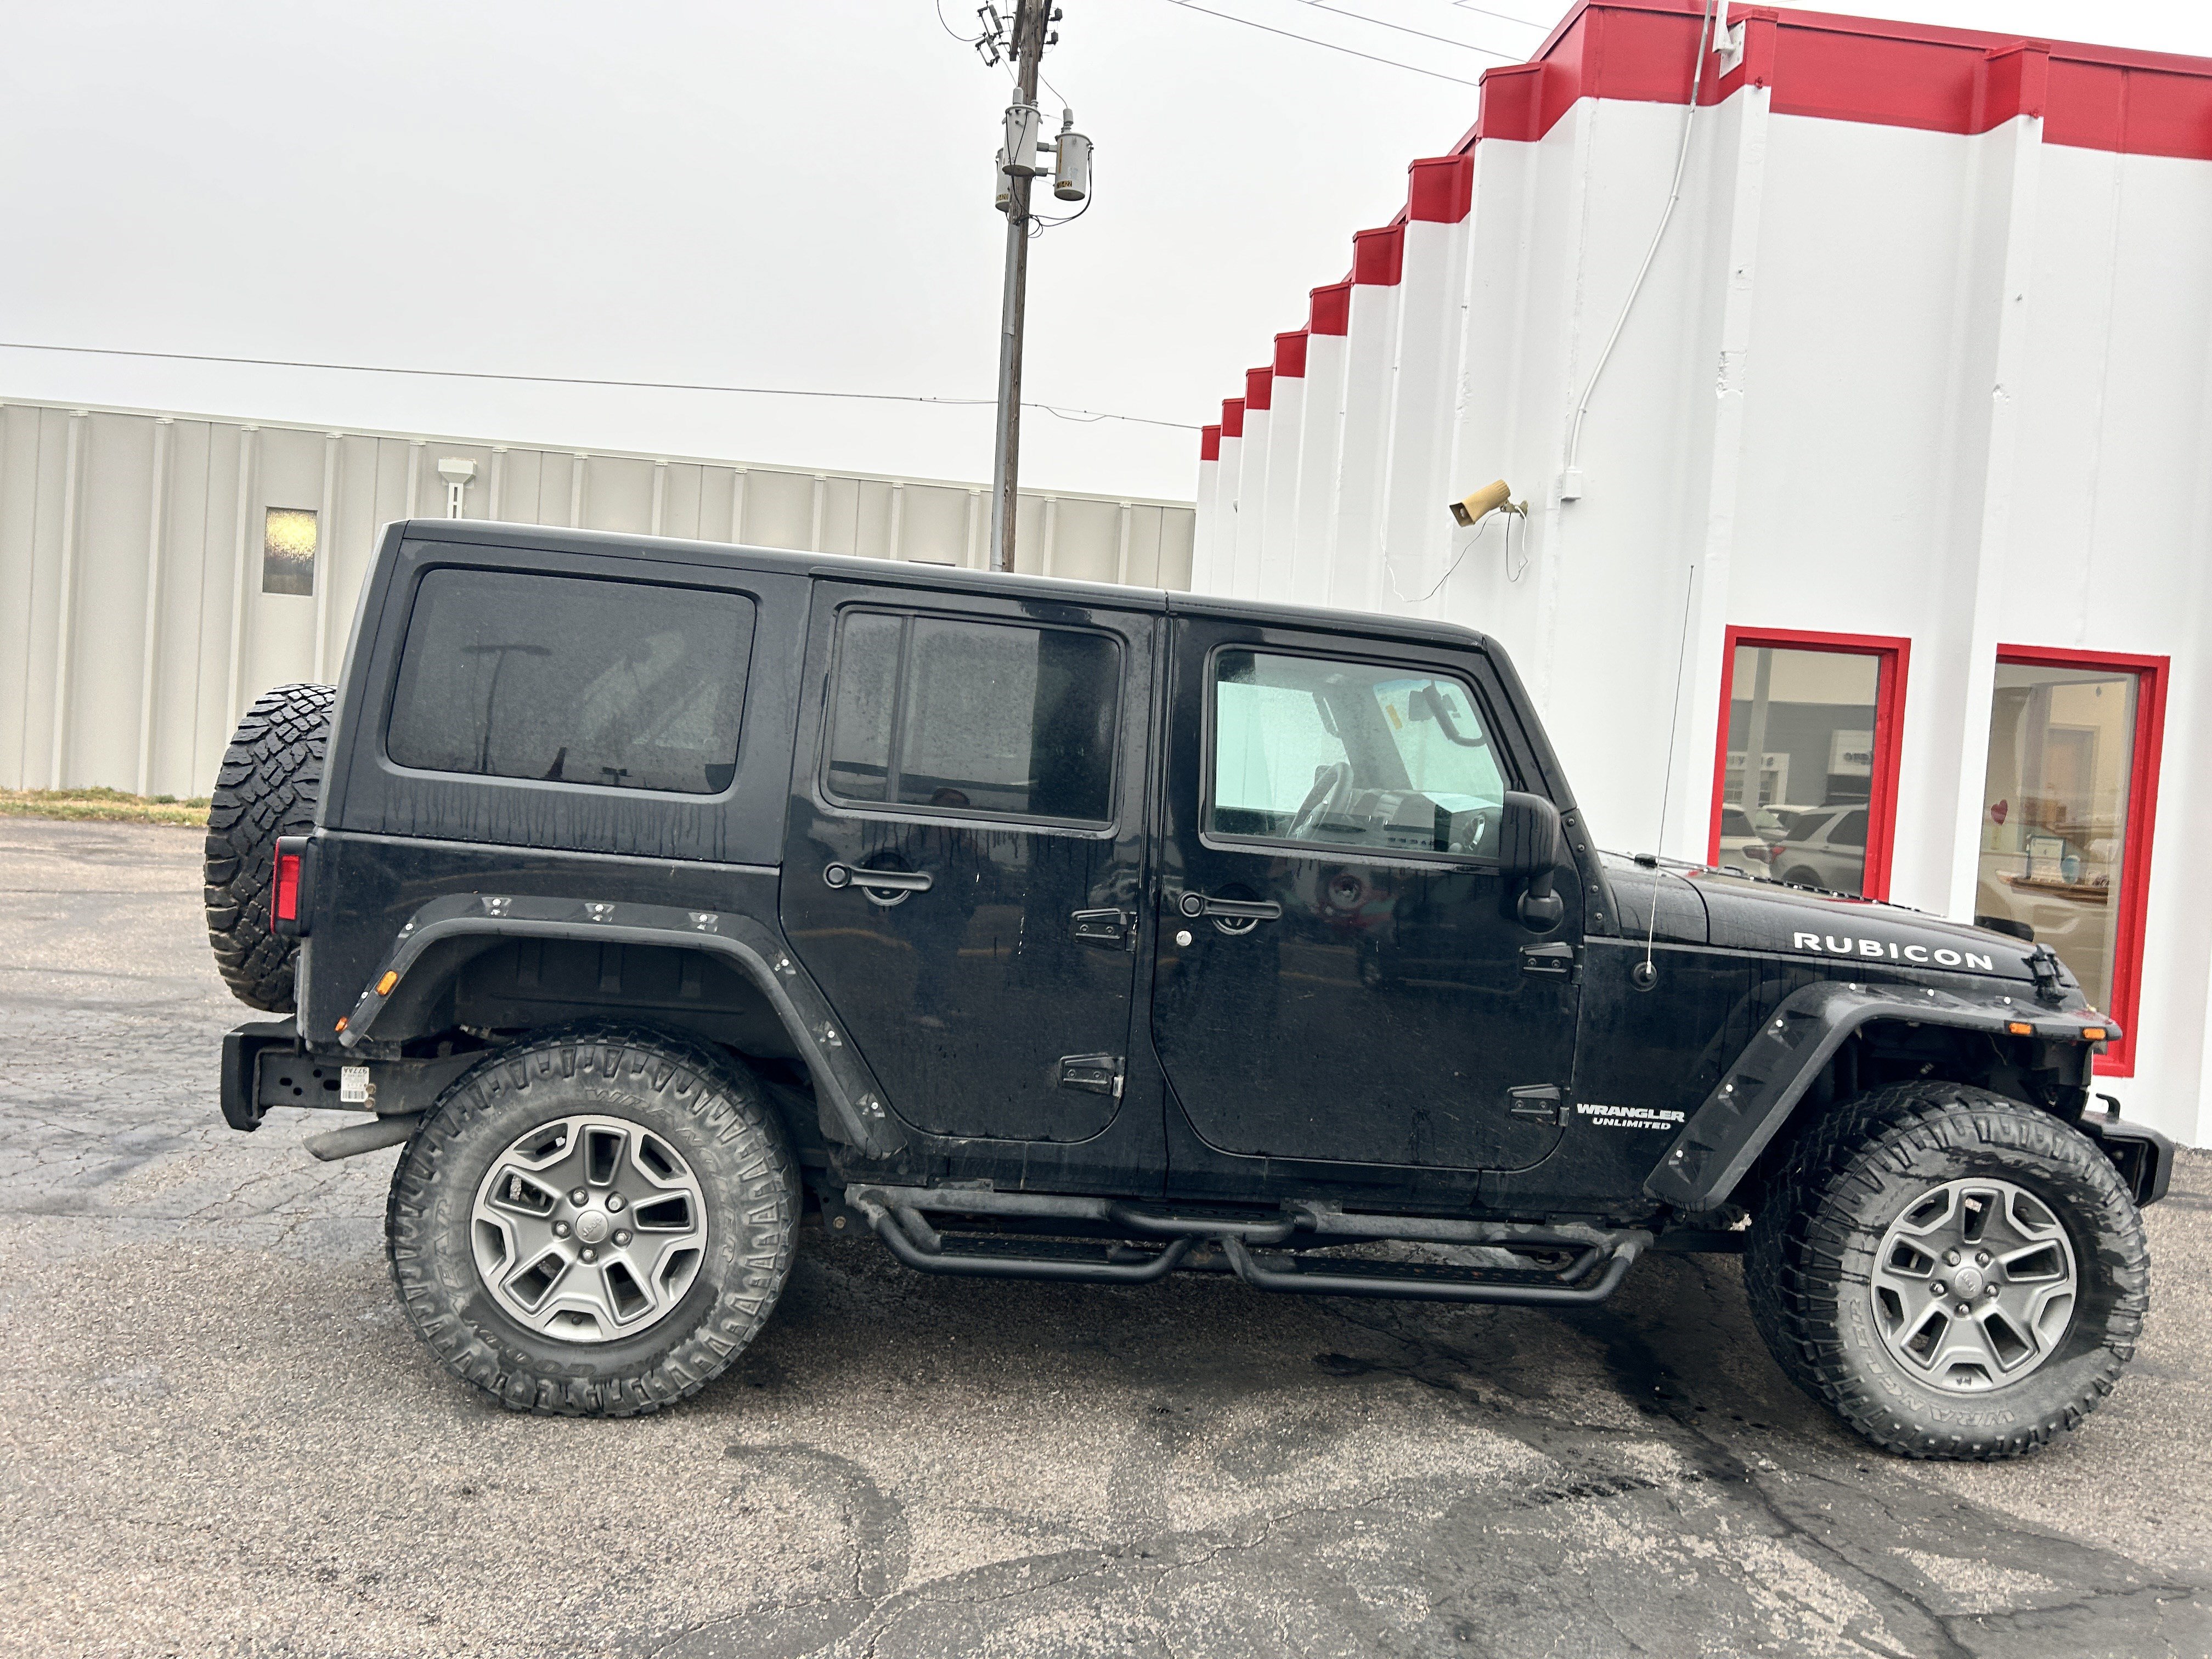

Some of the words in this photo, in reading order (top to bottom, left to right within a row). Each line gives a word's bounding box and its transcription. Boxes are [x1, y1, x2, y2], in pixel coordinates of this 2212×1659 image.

[1793, 932, 1993, 970] RUBICON
[1577, 1103, 1685, 1122] WRANGLER
[1593, 1117, 1671, 1130] UNLIMITED
